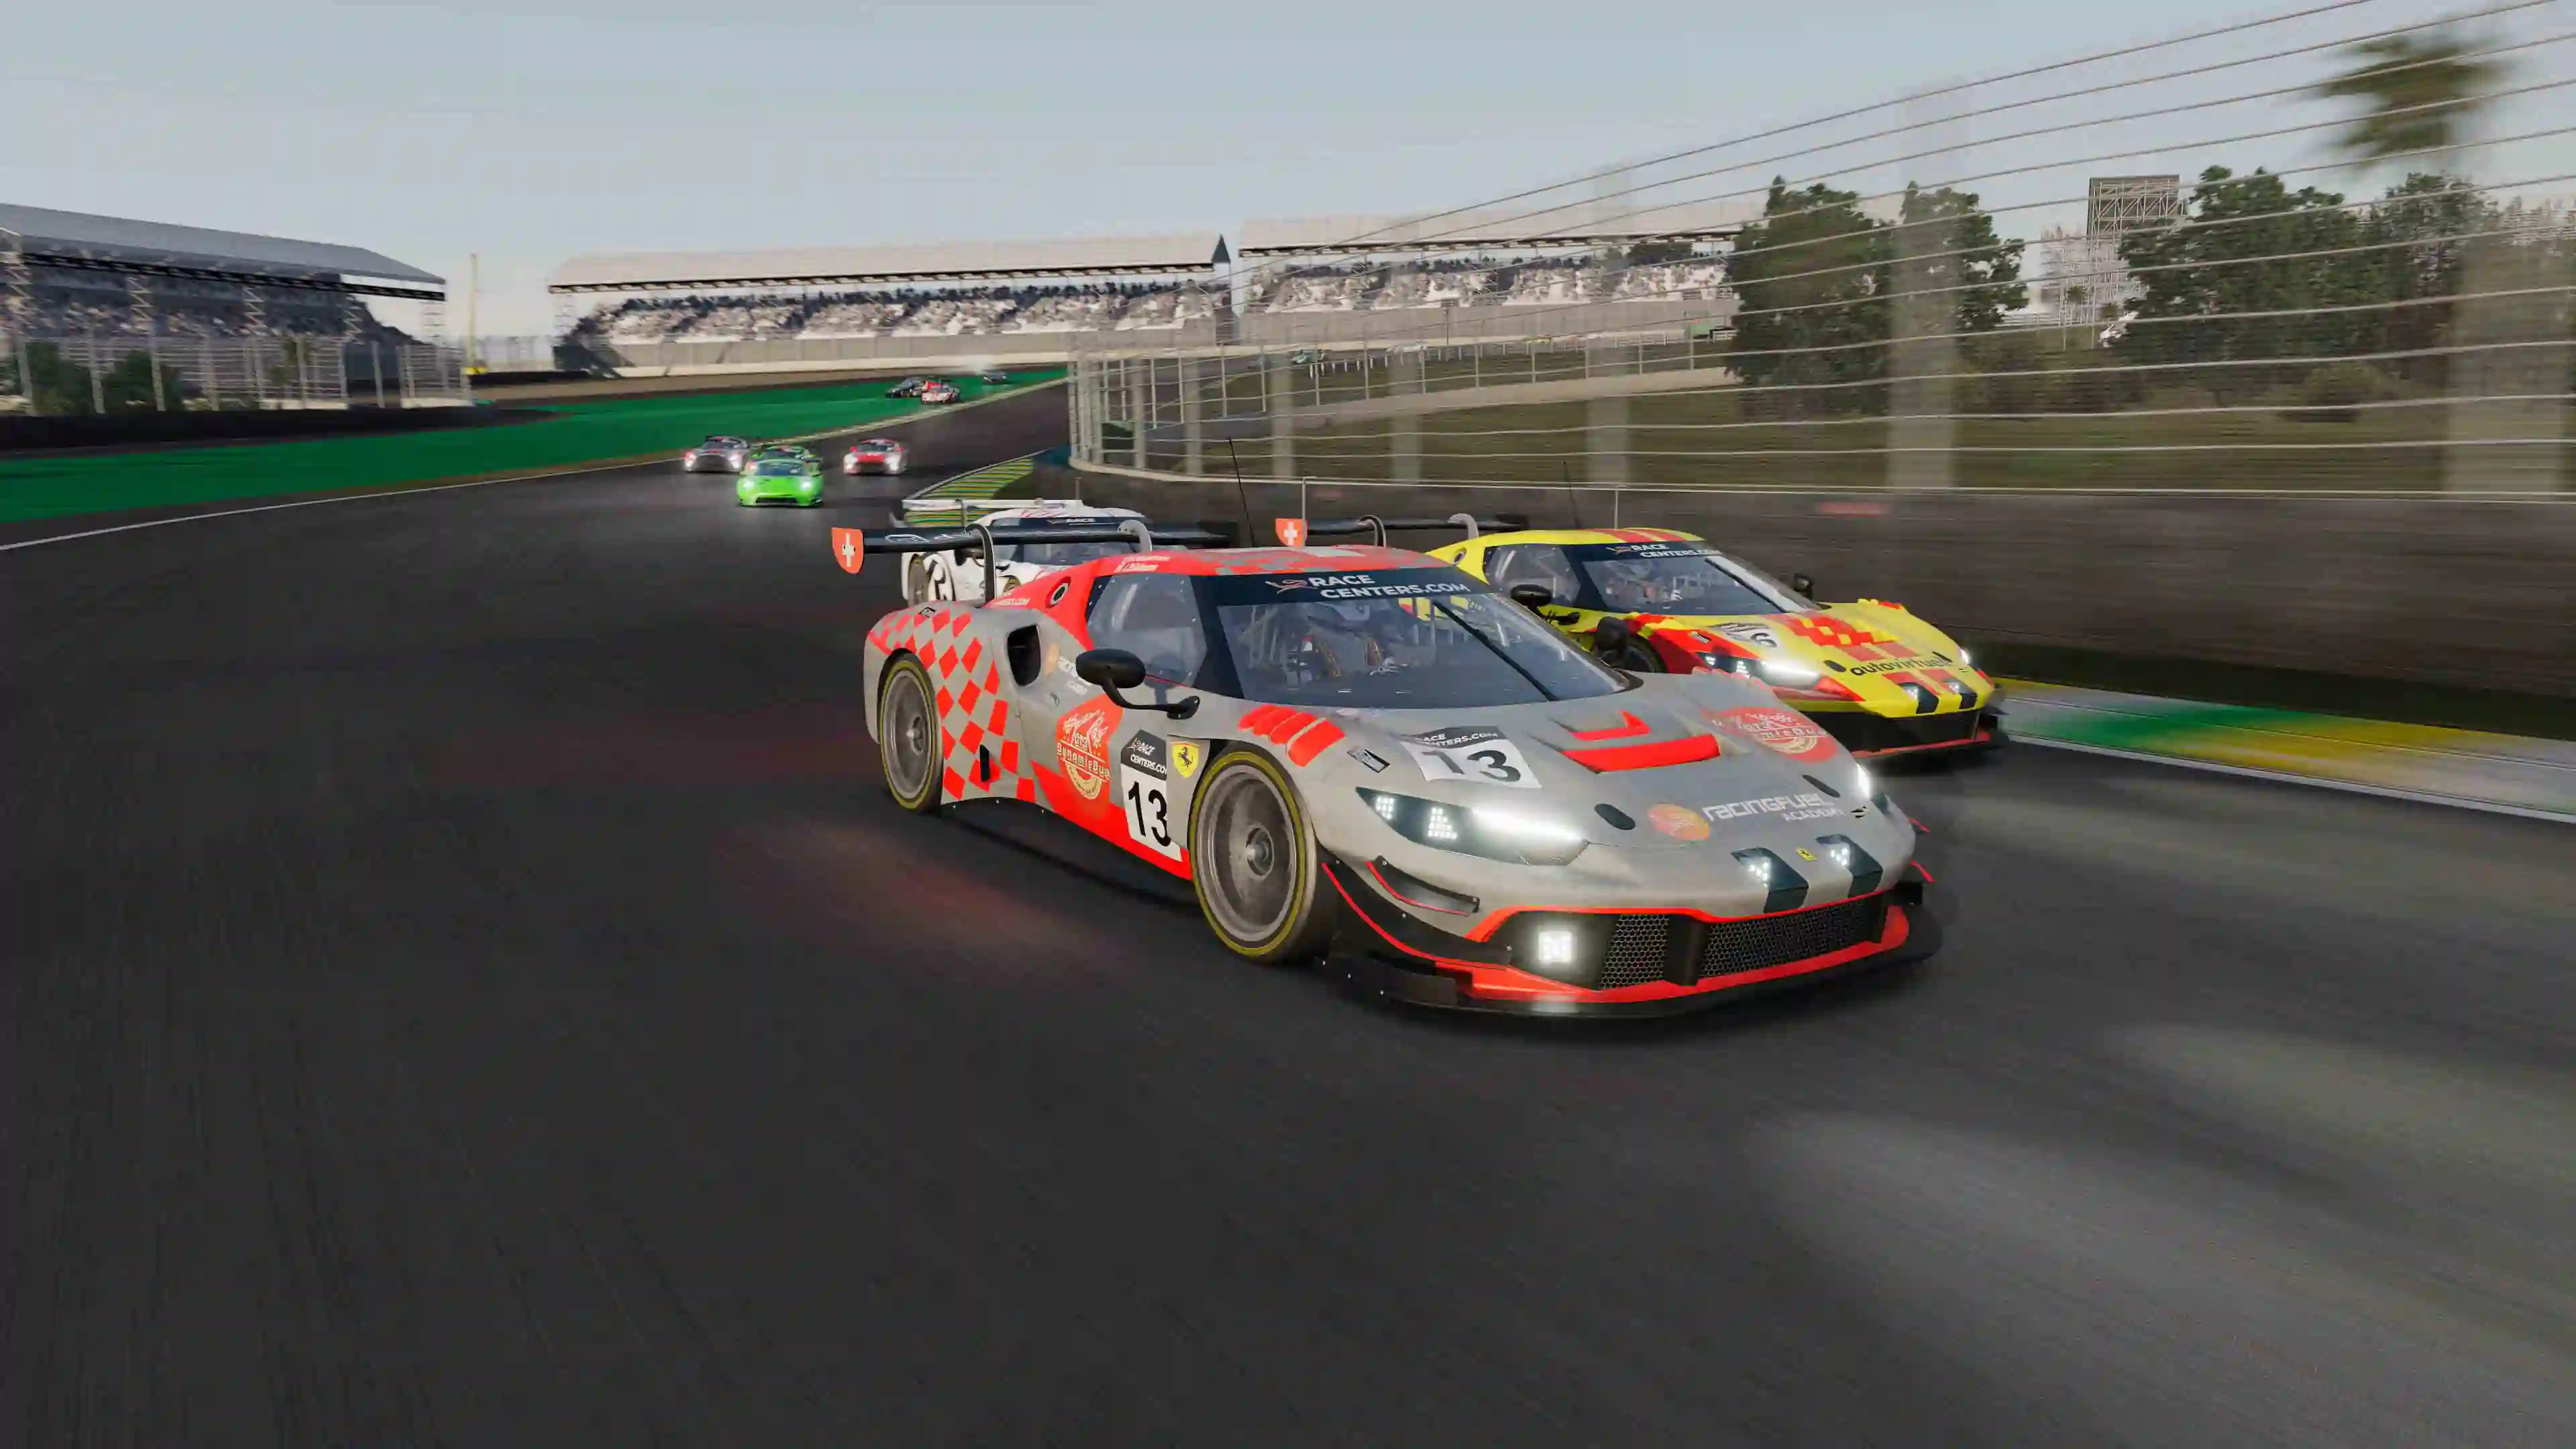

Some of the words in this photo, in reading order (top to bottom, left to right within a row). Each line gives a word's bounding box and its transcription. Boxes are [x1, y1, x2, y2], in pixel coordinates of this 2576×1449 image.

[1631, 543, 1669, 551] RACE
[1307, 574, 1375, 587] RACE
[1320, 583, 1471, 598] CENTERS.COM
[1421, 749, 1521, 782] 13
[1128, 781, 1171, 847] 13
